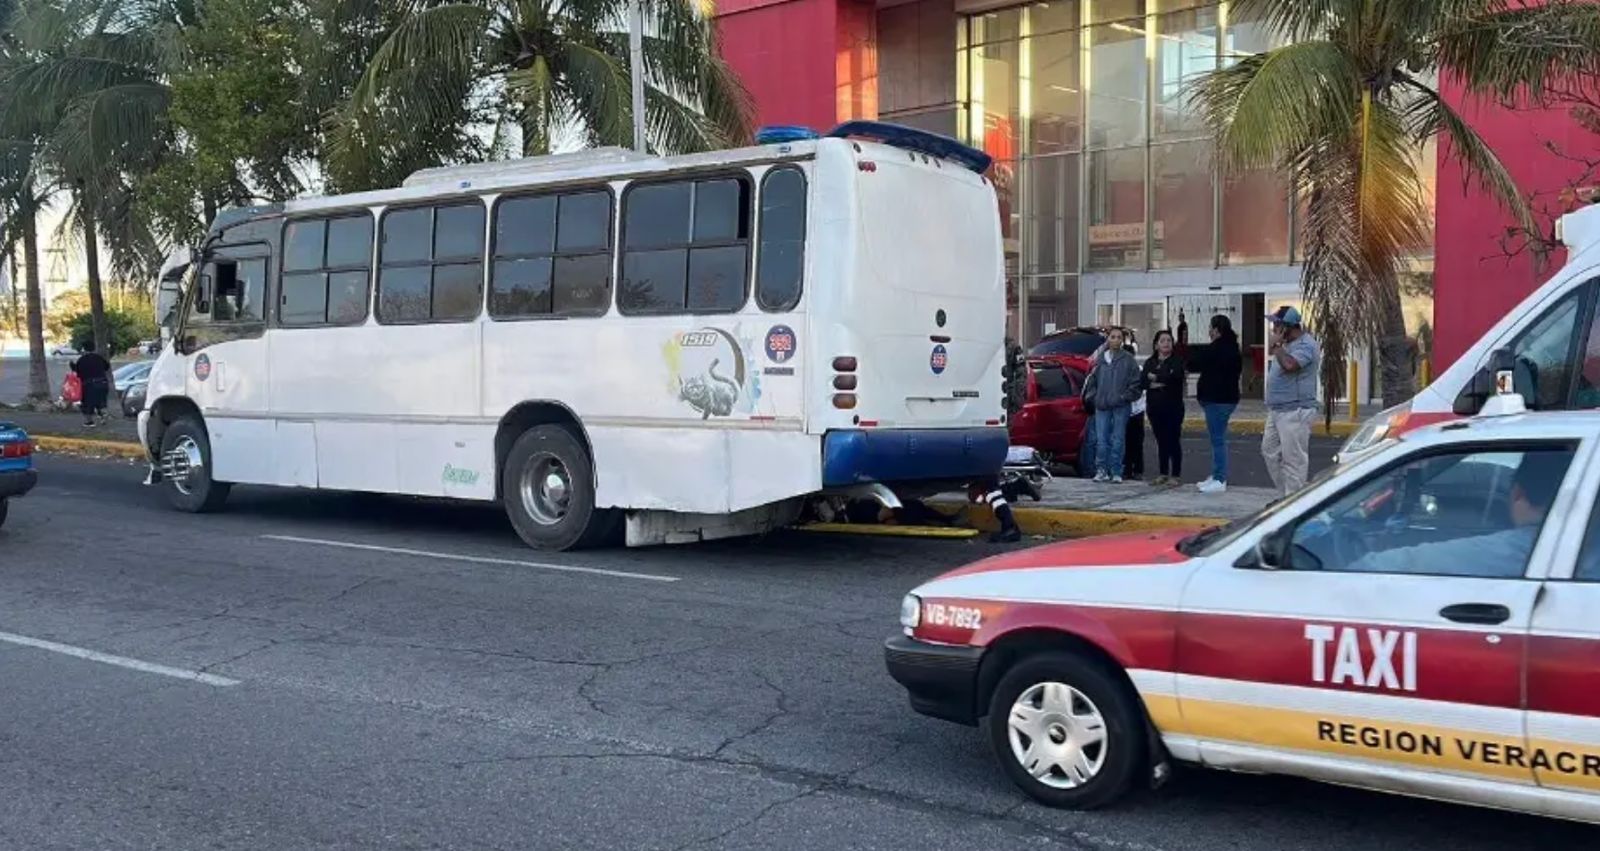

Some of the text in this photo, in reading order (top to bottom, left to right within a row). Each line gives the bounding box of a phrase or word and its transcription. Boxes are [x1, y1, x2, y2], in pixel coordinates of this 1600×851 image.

[926, 603, 982, 630] VB-7892
[1304, 624, 1418, 691] TAXI
[1317, 720, 1600, 776] REGION VERACR
